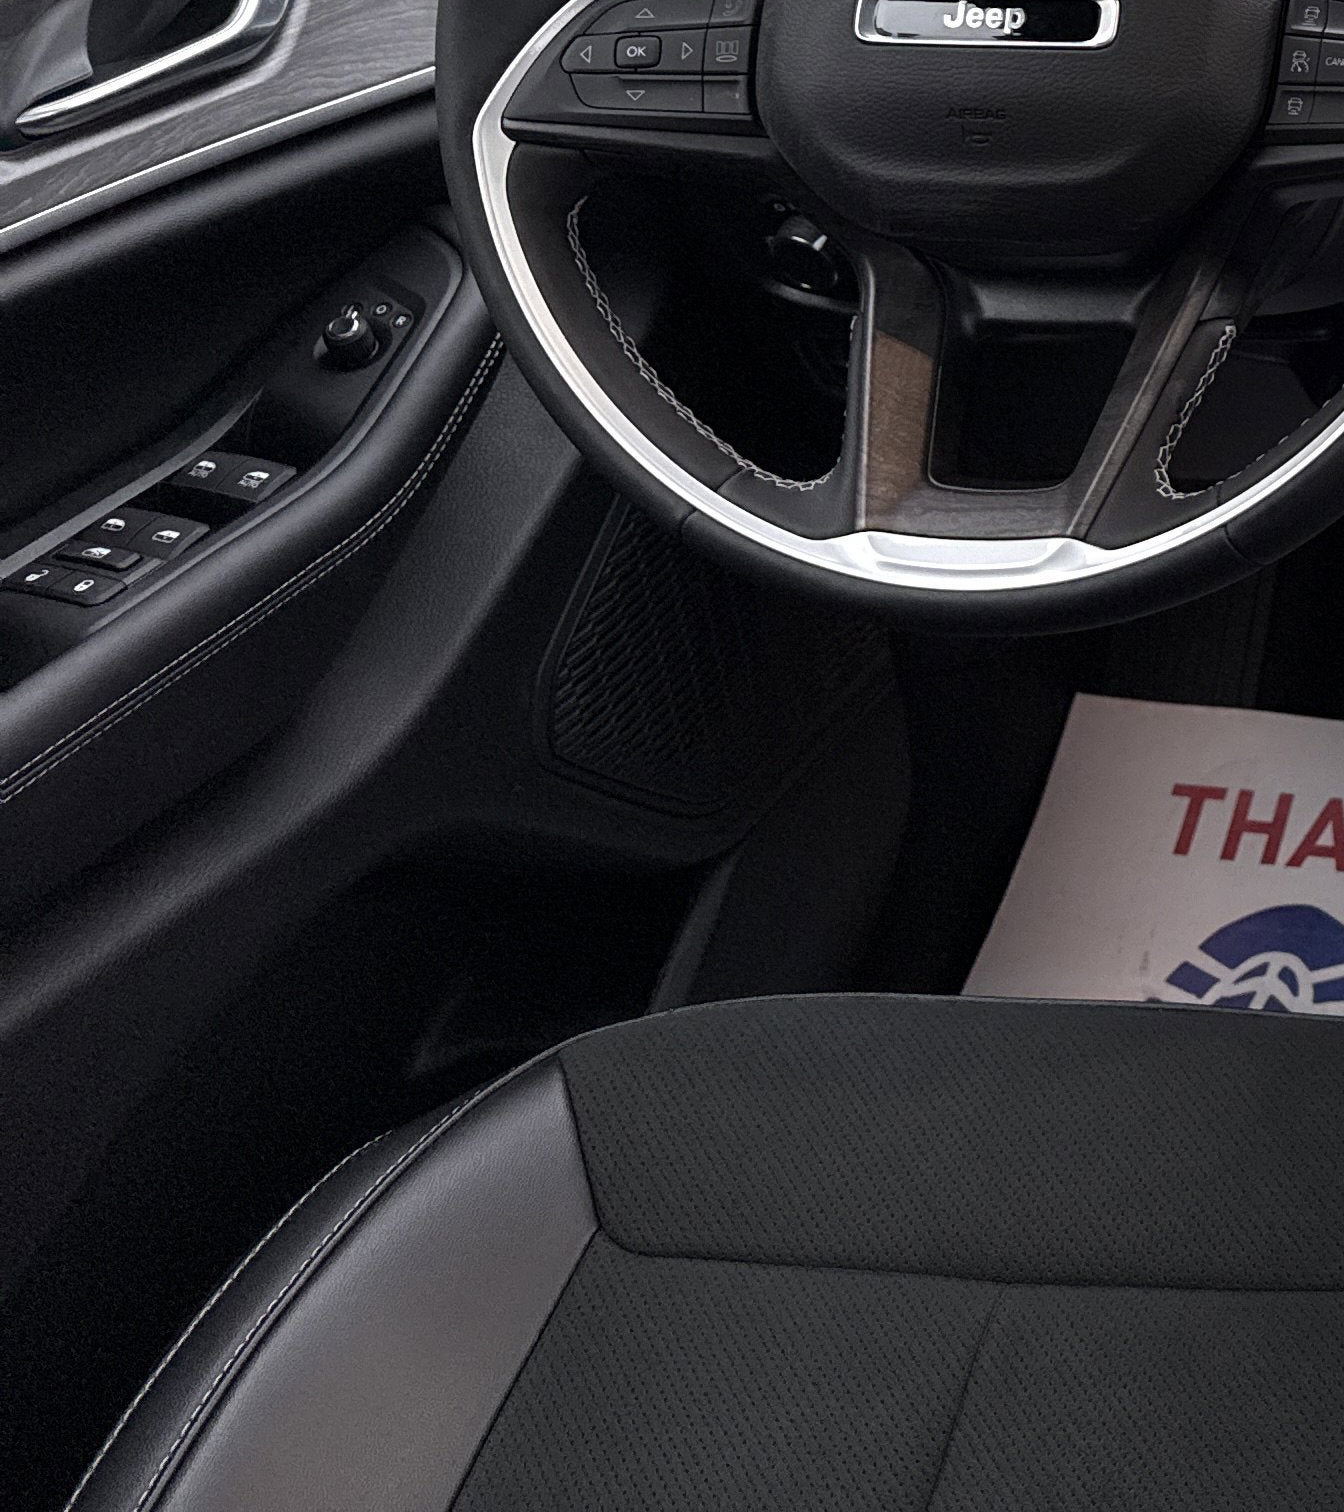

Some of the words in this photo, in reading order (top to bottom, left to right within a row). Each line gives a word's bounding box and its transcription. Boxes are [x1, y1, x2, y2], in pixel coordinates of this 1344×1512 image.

[943, 0, 1026, 35] Jeep
[626, 44, 647, 59] OK
[394, 314, 408, 327] R
